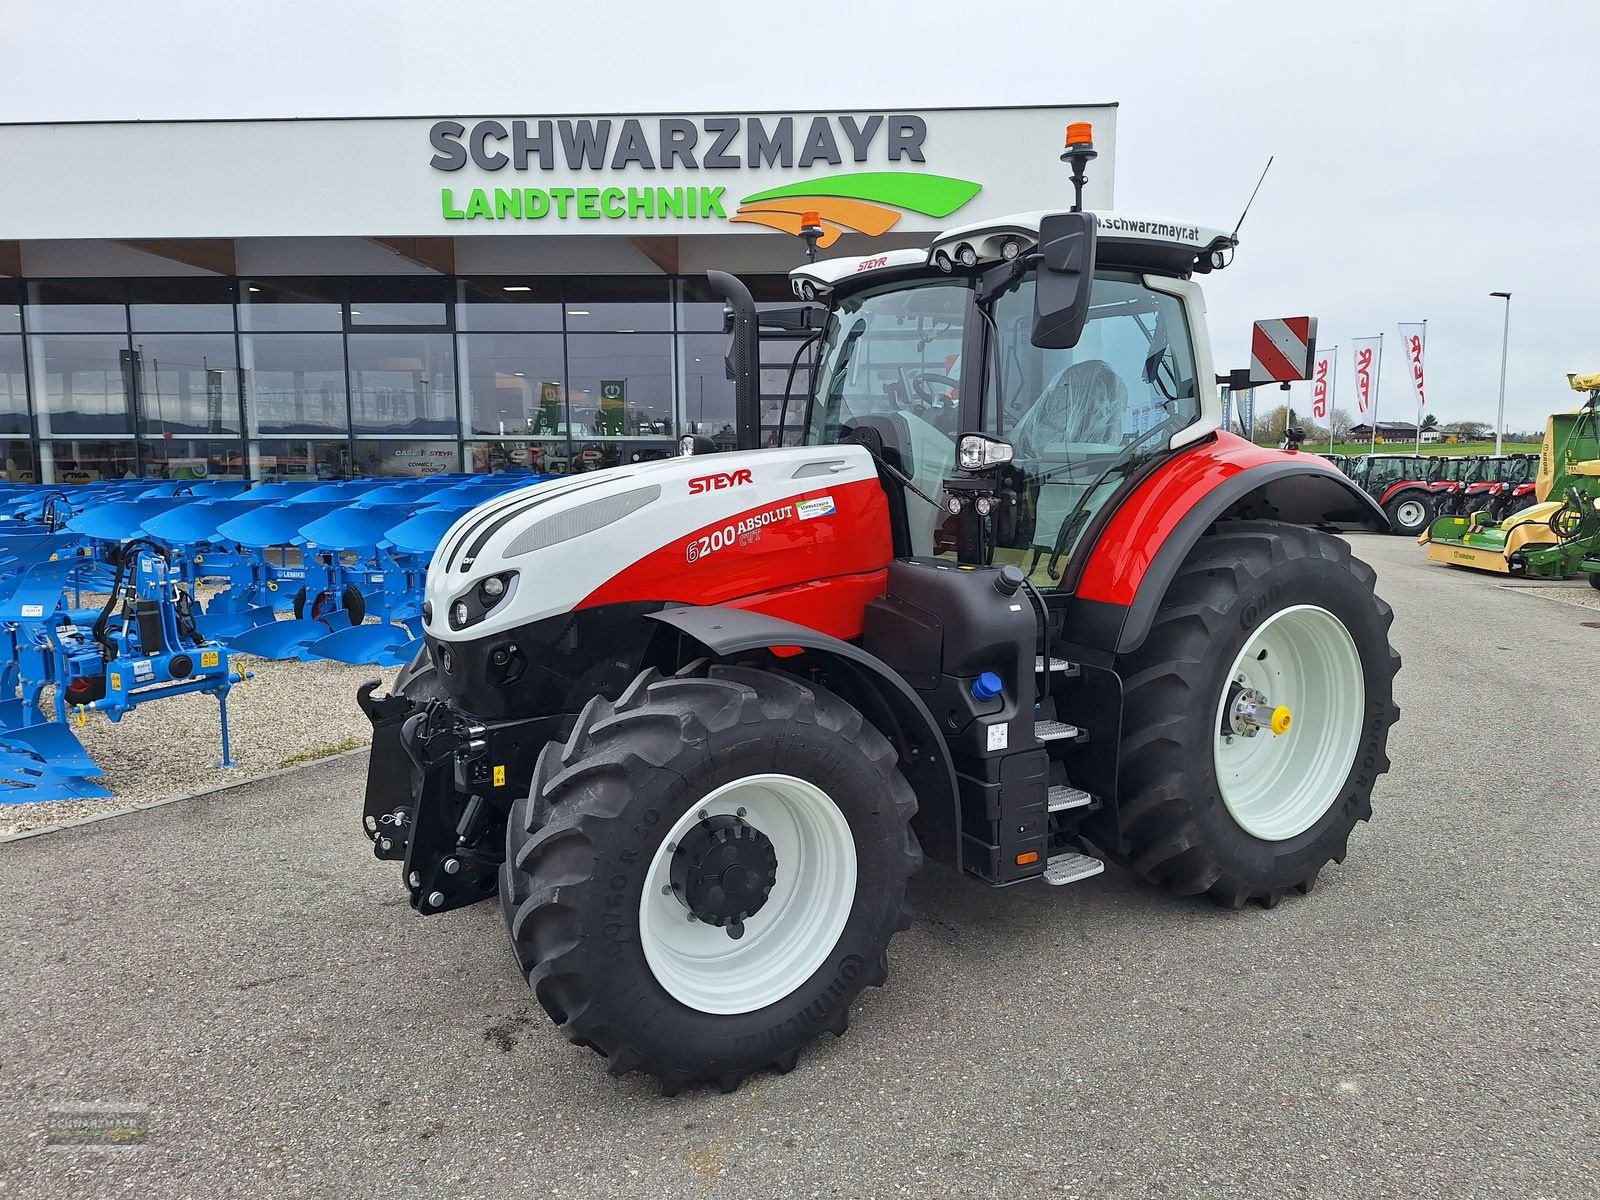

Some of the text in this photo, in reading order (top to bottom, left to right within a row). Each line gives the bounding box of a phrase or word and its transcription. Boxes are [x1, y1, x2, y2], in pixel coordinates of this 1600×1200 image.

[429, 115, 927, 171] SCHWARZMAYR
[441, 187, 726, 220] LANDTECHNIK
[857, 257, 887, 271] STEYR
[689, 469, 753, 495] STEYR
[801, 501, 829, 511] SCHWARZMAYR
[686, 506, 793, 563] 6200 ABSOLUT
[739, 530, 761, 546] CVT
[1356, 774, 1368, 788] R
[1342, 793, 1359, 817] 42
